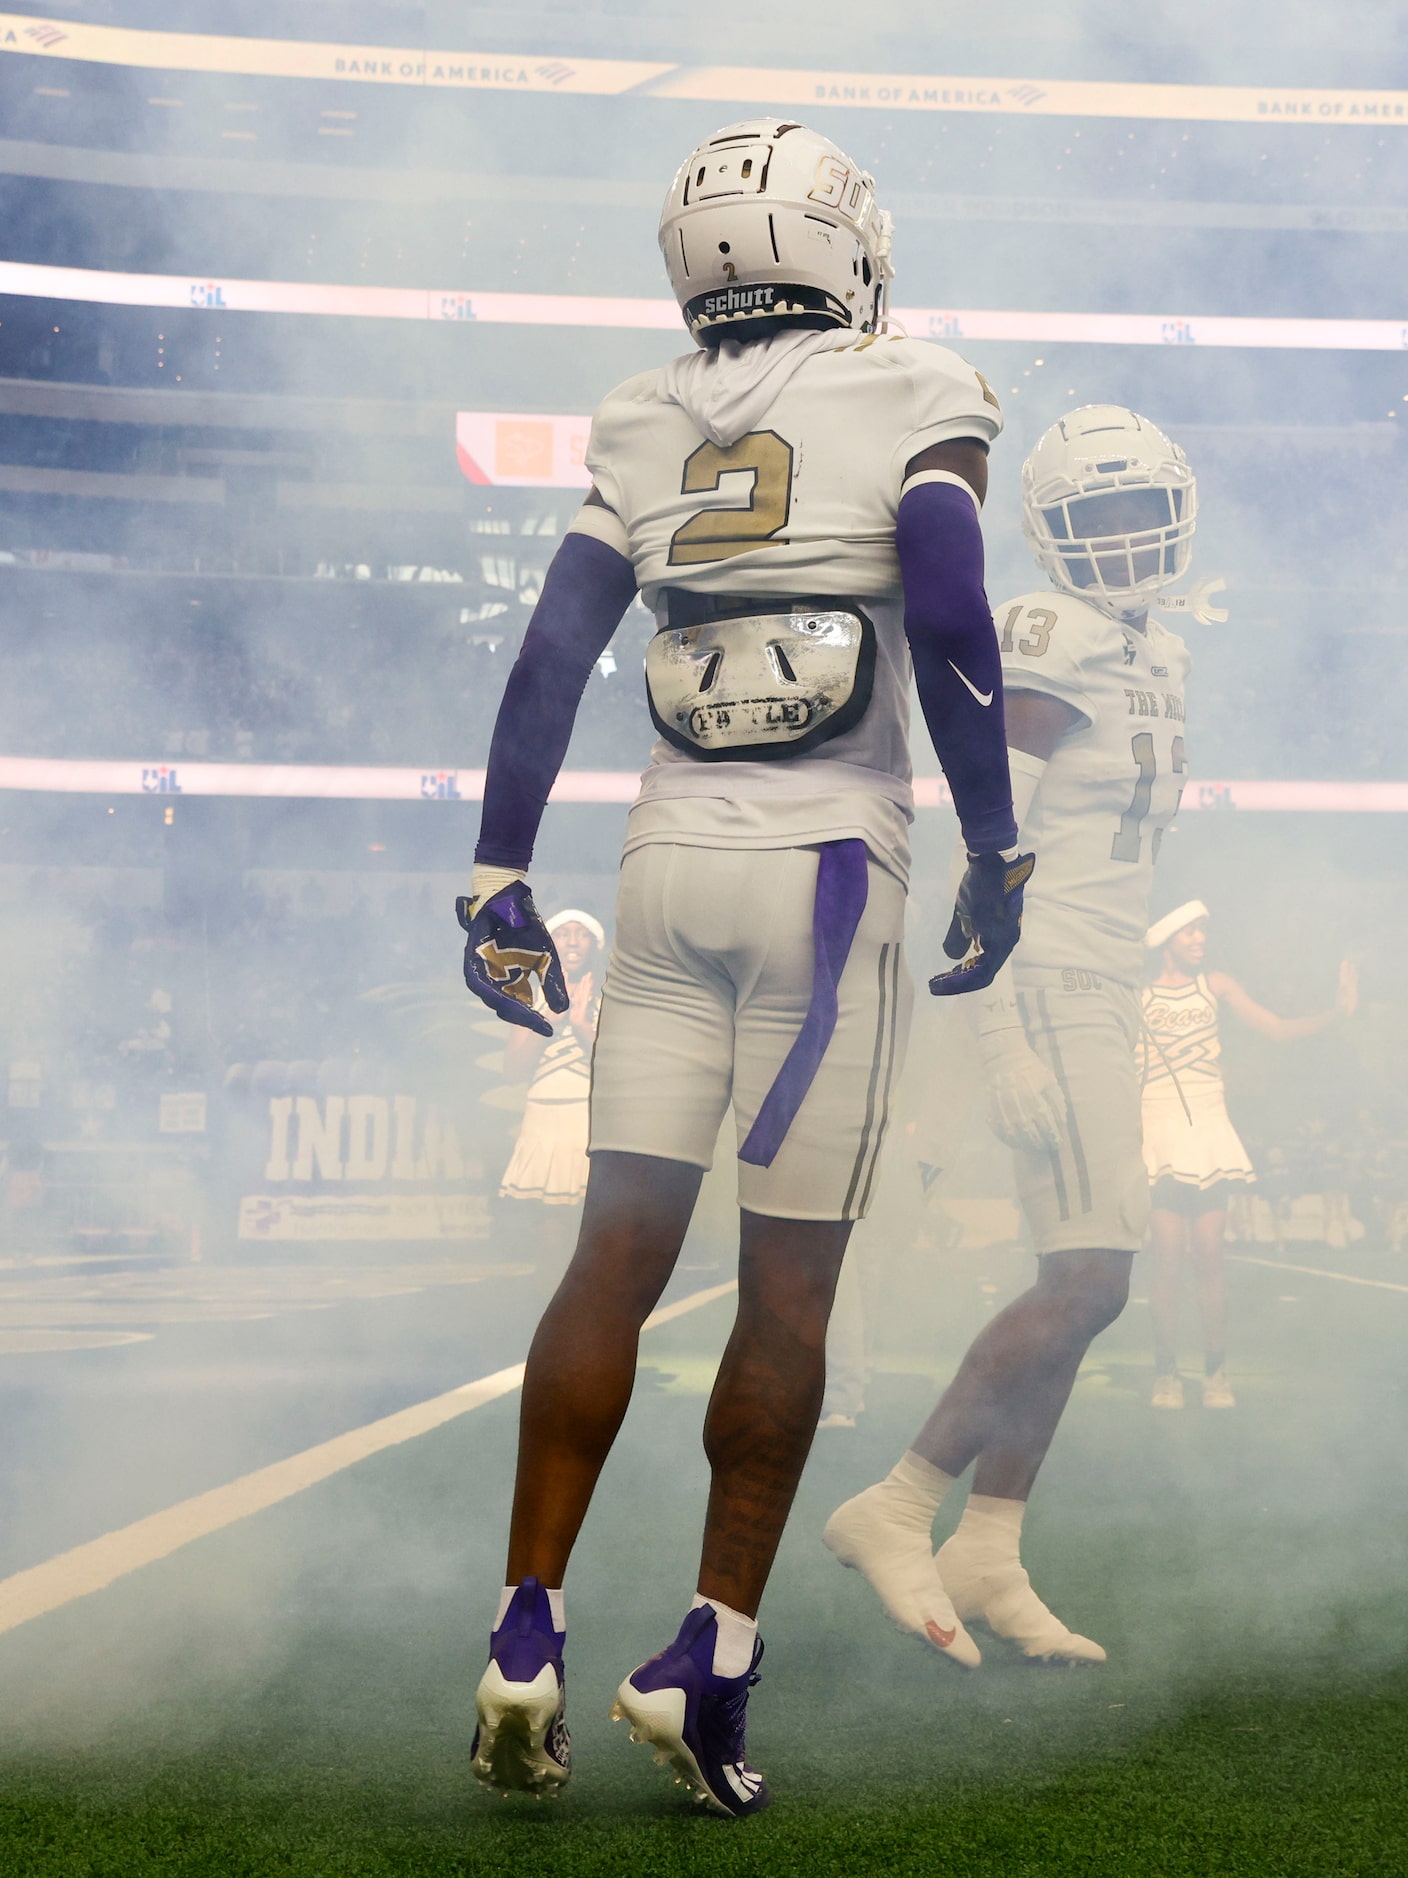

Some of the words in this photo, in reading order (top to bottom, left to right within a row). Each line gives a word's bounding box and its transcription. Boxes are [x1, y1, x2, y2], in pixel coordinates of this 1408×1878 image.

[335, 58, 392, 75] BANK
[400, 62, 425, 77] OF
[433, 65, 529, 82] AMERICA
[815, 84, 872, 100] BANK
[877, 86, 902, 101] OF
[908, 88, 1001, 104] AMERICA
[1257, 101, 1312, 115] BANK
[1317, 102, 1342, 116] OF
[722, 262, 739, 283] 2
[705, 287, 775, 314] schutt
[666, 429, 794, 567] 2
[1000, 605, 1058, 658] 13
[1124, 689, 1159, 717] THE
[1144, 1003, 1213, 1031] Bears
